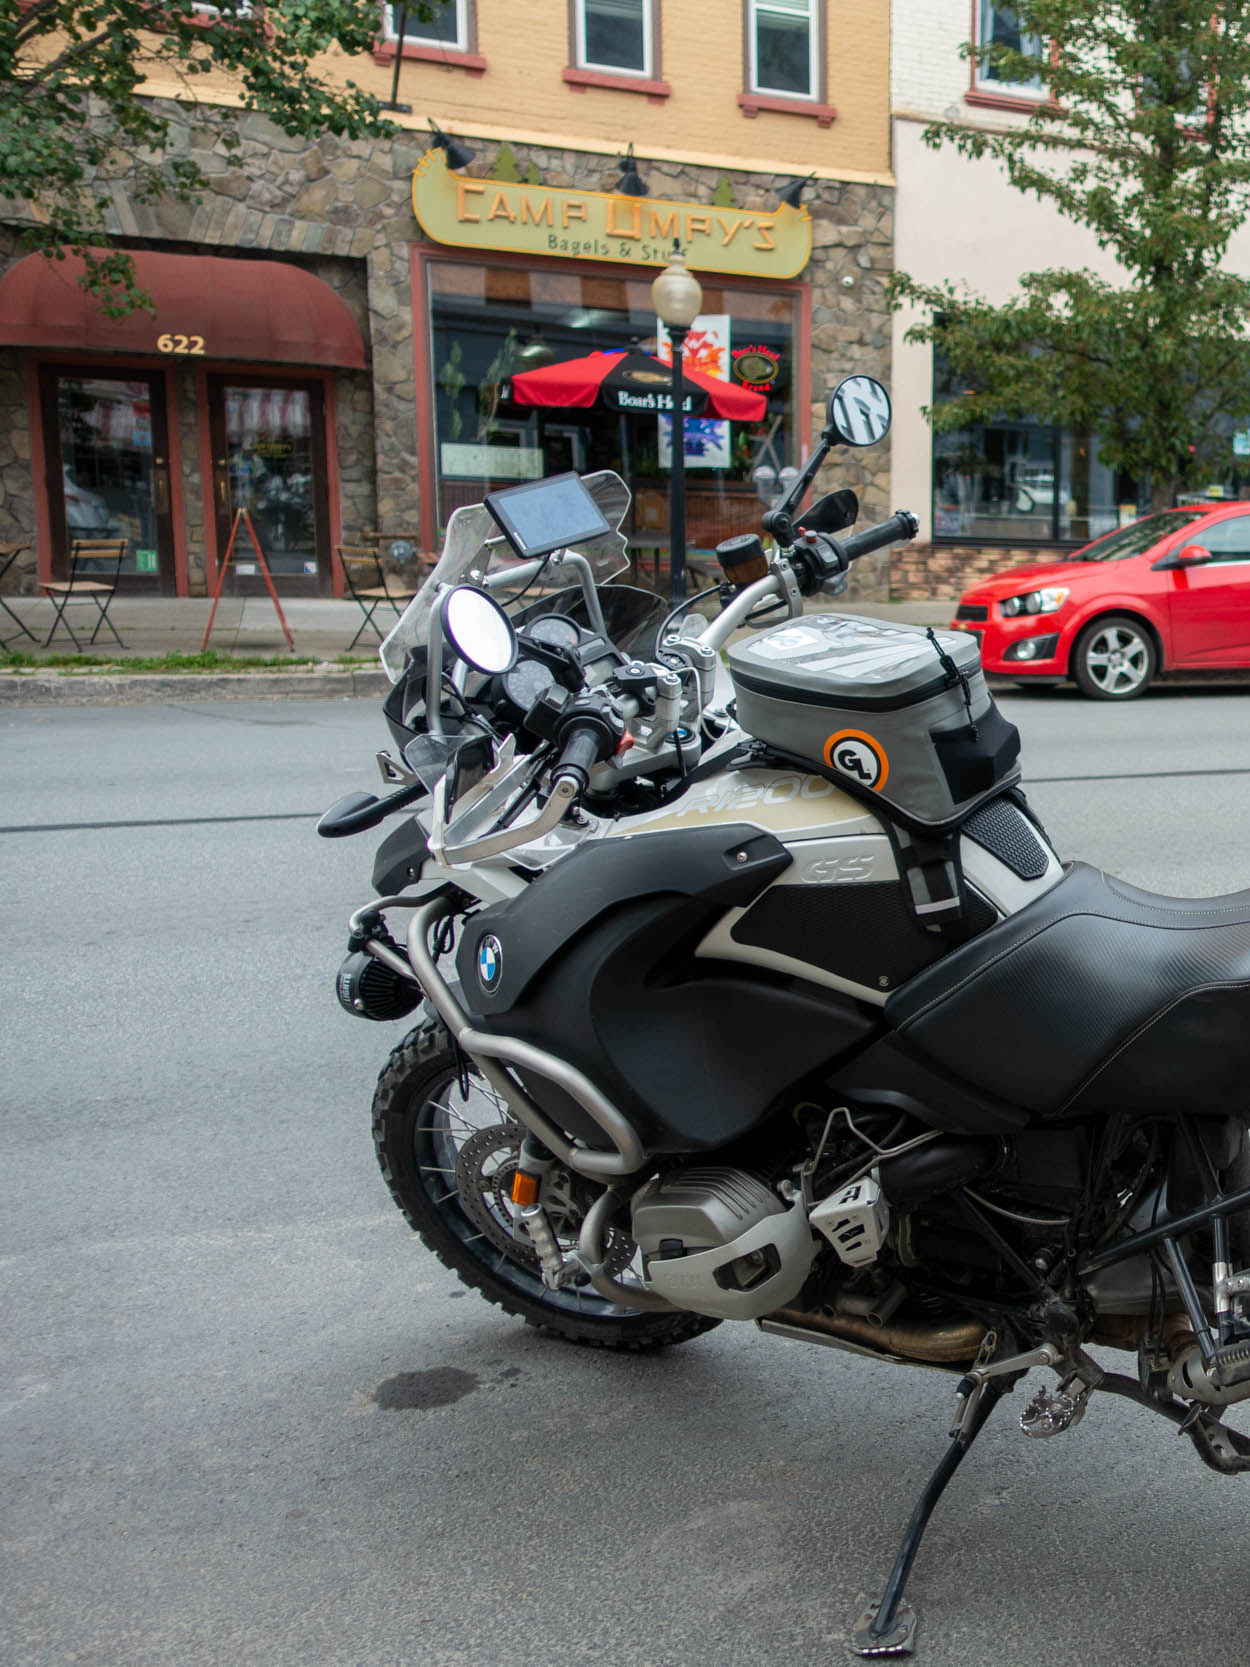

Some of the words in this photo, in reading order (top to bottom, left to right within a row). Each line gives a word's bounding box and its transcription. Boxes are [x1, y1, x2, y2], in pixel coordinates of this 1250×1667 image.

[456, 182, 590, 230] CAMP
[605, 197, 776, 252] UMPY'S
[548, 233, 610, 257] Bagels
[619, 241, 632, 258] &
[156, 332, 206, 355] 622
[837, 749, 873, 780] GL
[799, 855, 875, 885] GS
